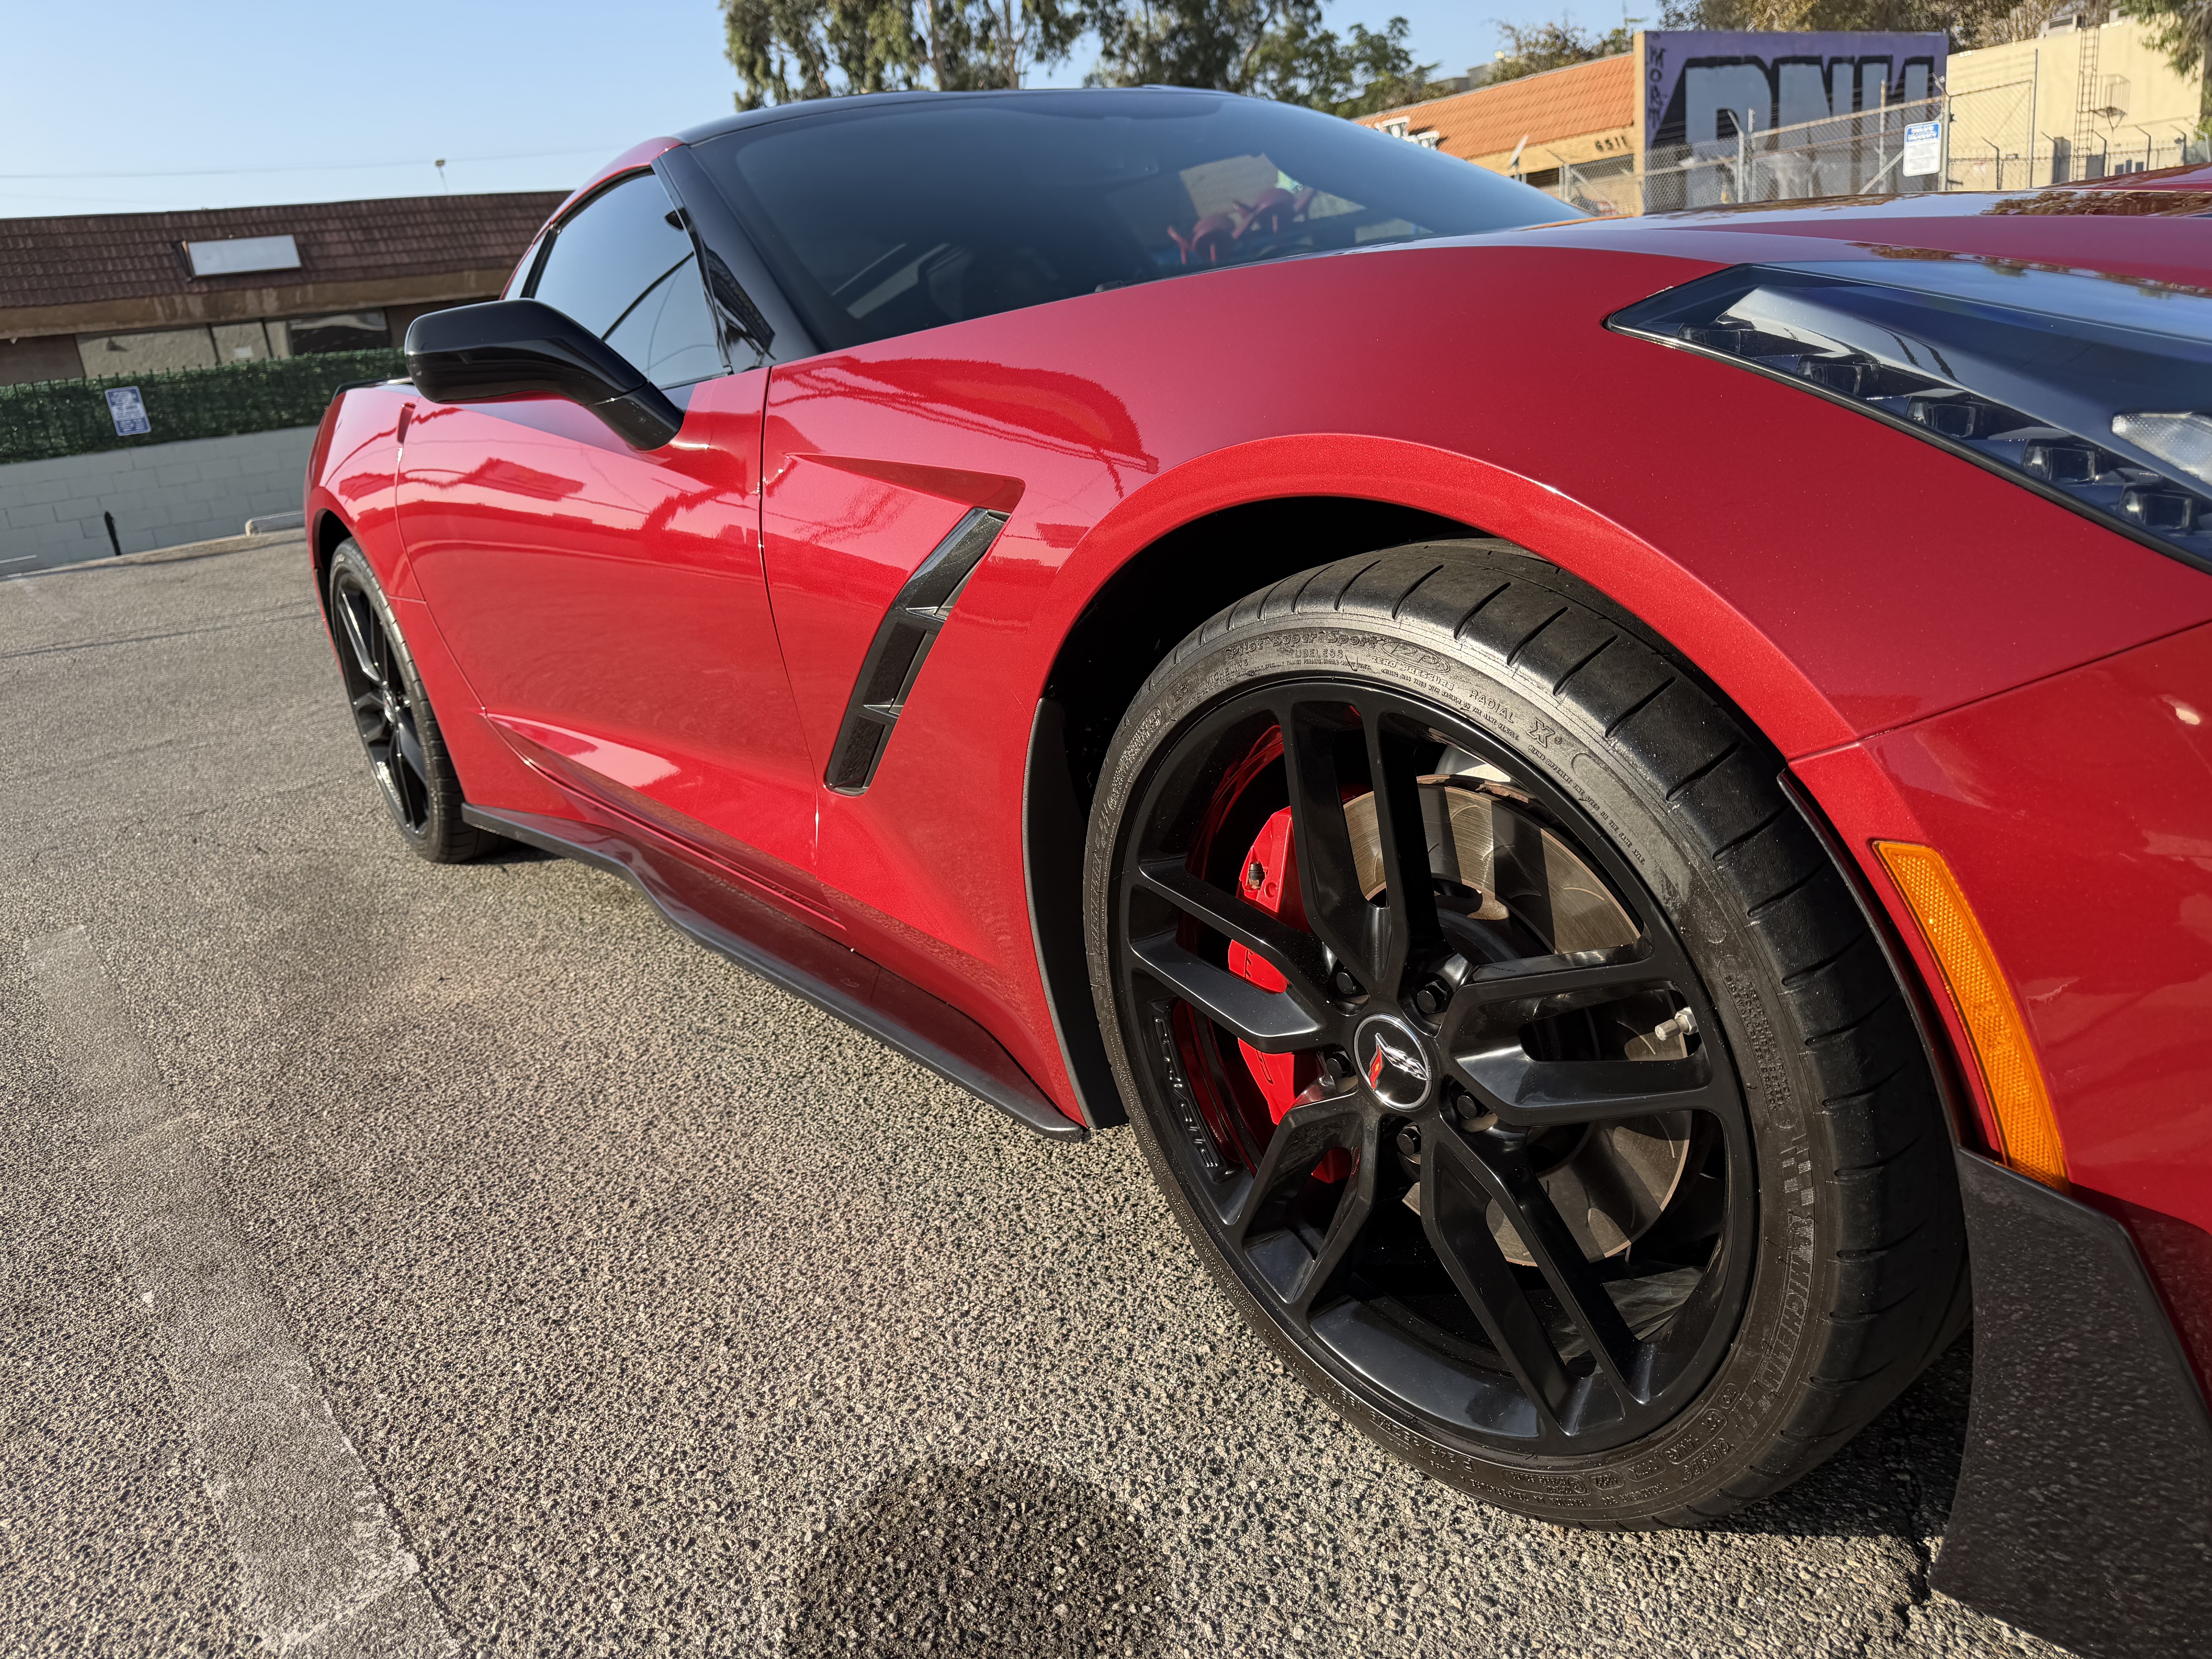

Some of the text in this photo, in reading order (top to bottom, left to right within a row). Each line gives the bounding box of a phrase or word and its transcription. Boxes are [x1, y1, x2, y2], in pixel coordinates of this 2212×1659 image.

[1595, 136, 1628, 152] 6511
[1290, 649, 1343, 658] TUBELESS
[1402, 665, 1455, 690] PRESSURE
[1469, 690, 1514, 723] RADIAL
[1545, 757, 1573, 784] DIFFERENT
[1599, 810, 1609, 821] ON
[1607, 819, 1619, 832] THE
[1617, 831, 1633, 848] SAME
[1758, 1253, 1813, 1391] MICHELIN
[1681, 1436, 1732, 1480] OUTSIDE
